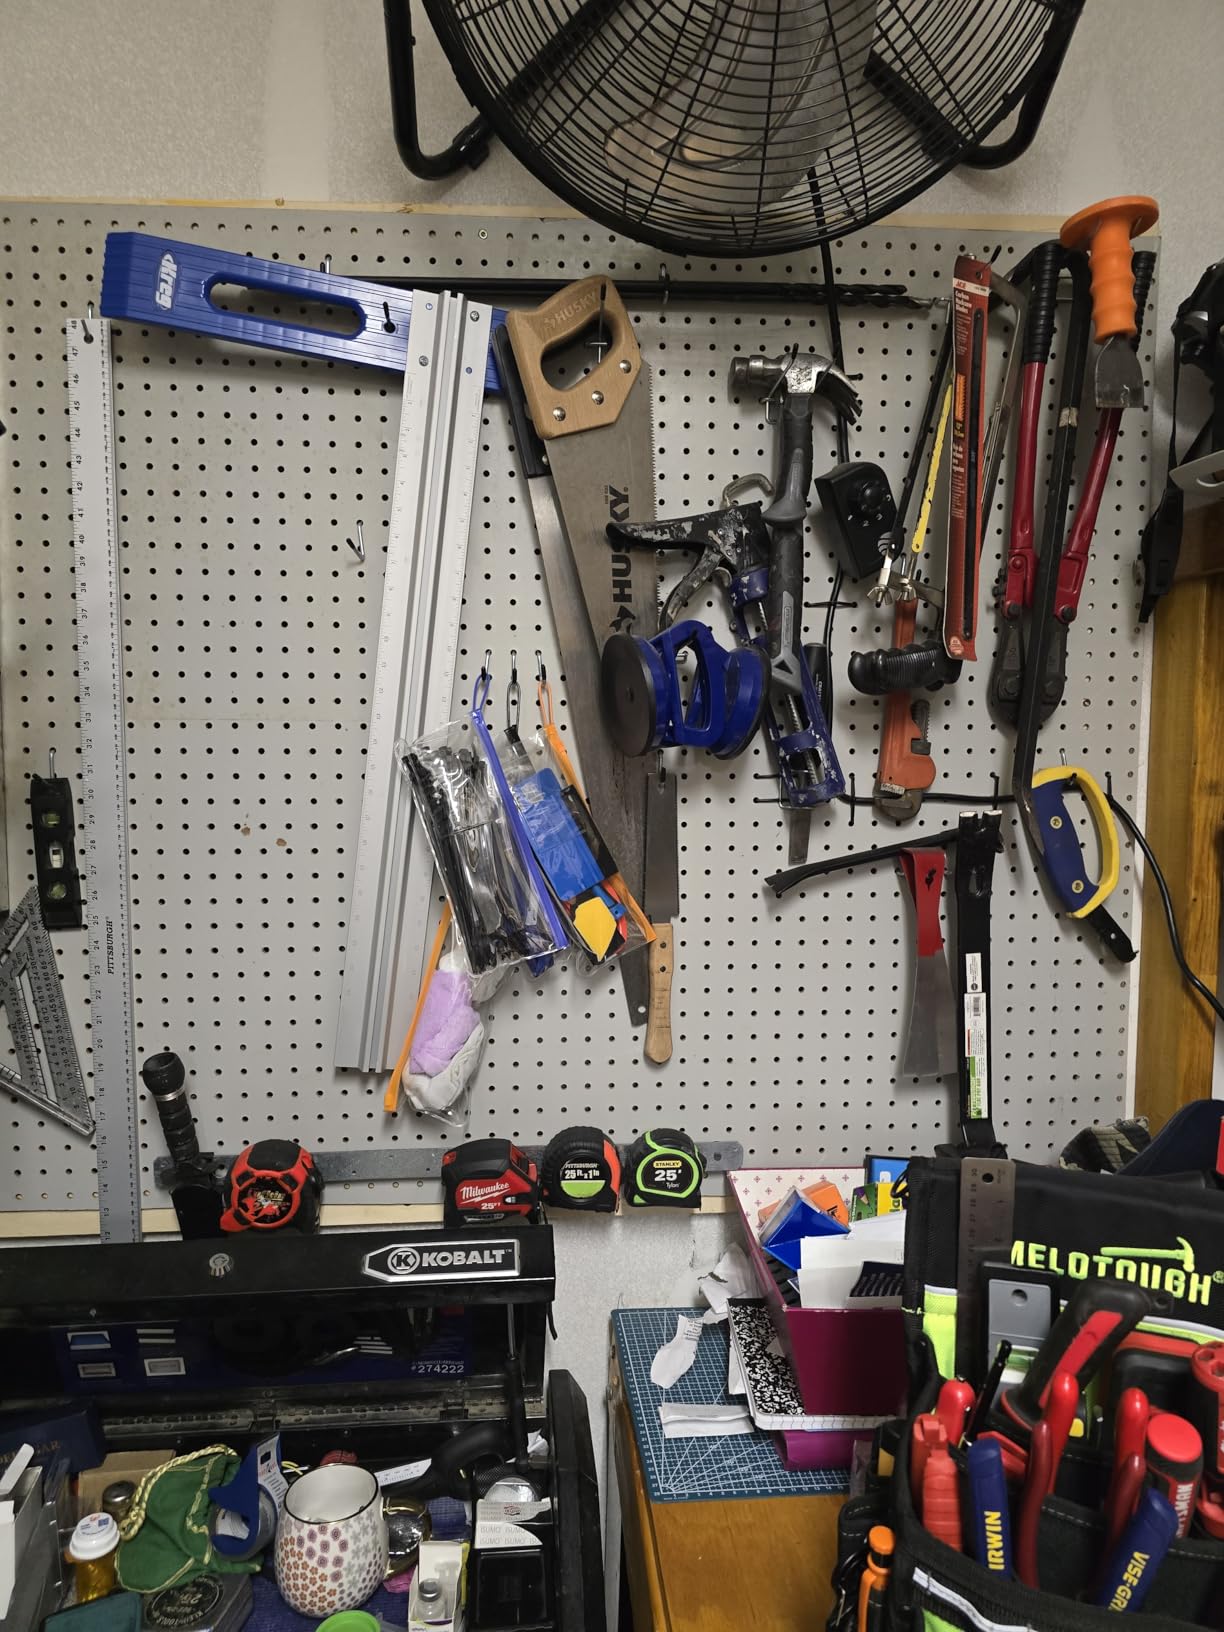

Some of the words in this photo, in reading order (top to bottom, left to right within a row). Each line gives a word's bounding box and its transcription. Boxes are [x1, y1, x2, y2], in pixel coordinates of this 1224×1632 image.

[156, 259, 178, 310] Kreg
[555, 291, 597, 321] HUSKY
[72, 320, 78, 330] 48
[72, 348, 78, 357] 47
[73, 374, 79, 384] 46
[74, 401, 80, 411] 45
[75, 428, 81, 438] 44
[76, 455, 82, 465] 43
[77, 481, 83, 491] 42
[78, 508, 84, 517] 41
[79, 534, 85, 544] 40
[609, 484, 633, 603] HUKY
[80, 556, 86, 566] 39
[81, 583, 87, 592] 38
[82, 608, 88, 619] 37
[82, 635, 89, 645] 36
[84, 660, 90, 671] 35
[84, 686, 91, 697] 34
[86, 712, 92, 723] 33
[86, 738, 92, 748] 32
[87, 764, 93, 774] 31
[88, 789, 94, 799] 30
[89, 814, 95, 824] 29
[90, 840, 96, 849] 28
[91, 865, 97, 875] 27
[92, 890, 98, 900] 26
[93, 915, 99, 925] 25
[94, 940, 100, 950] 24
[95, 965, 101, 975] 23
[96, 990, 102, 999] 22
[97, 1015, 103, 1024] 21
[97, 1039, 103, 1048] 20
[98, 1063, 104, 1072] 19
[99, 1087, 105, 1097] 18
[100, 1112, 106, 1121] 17
[101, 1136, 107, 1144] 16
[102, 1160, 108, 1169] 15
[565, 1169, 576, 1179] 25
[103, 1183, 109, 1192] 14
[461, 1182, 510, 1199] Milwaukee
[104, 1207, 110, 1217] 13
[105, 1232, 111, 1240] 12
[984, 1510, 1005, 1571] IRWIN
[1107, 1551, 1150, 1612] VISE-GRI
